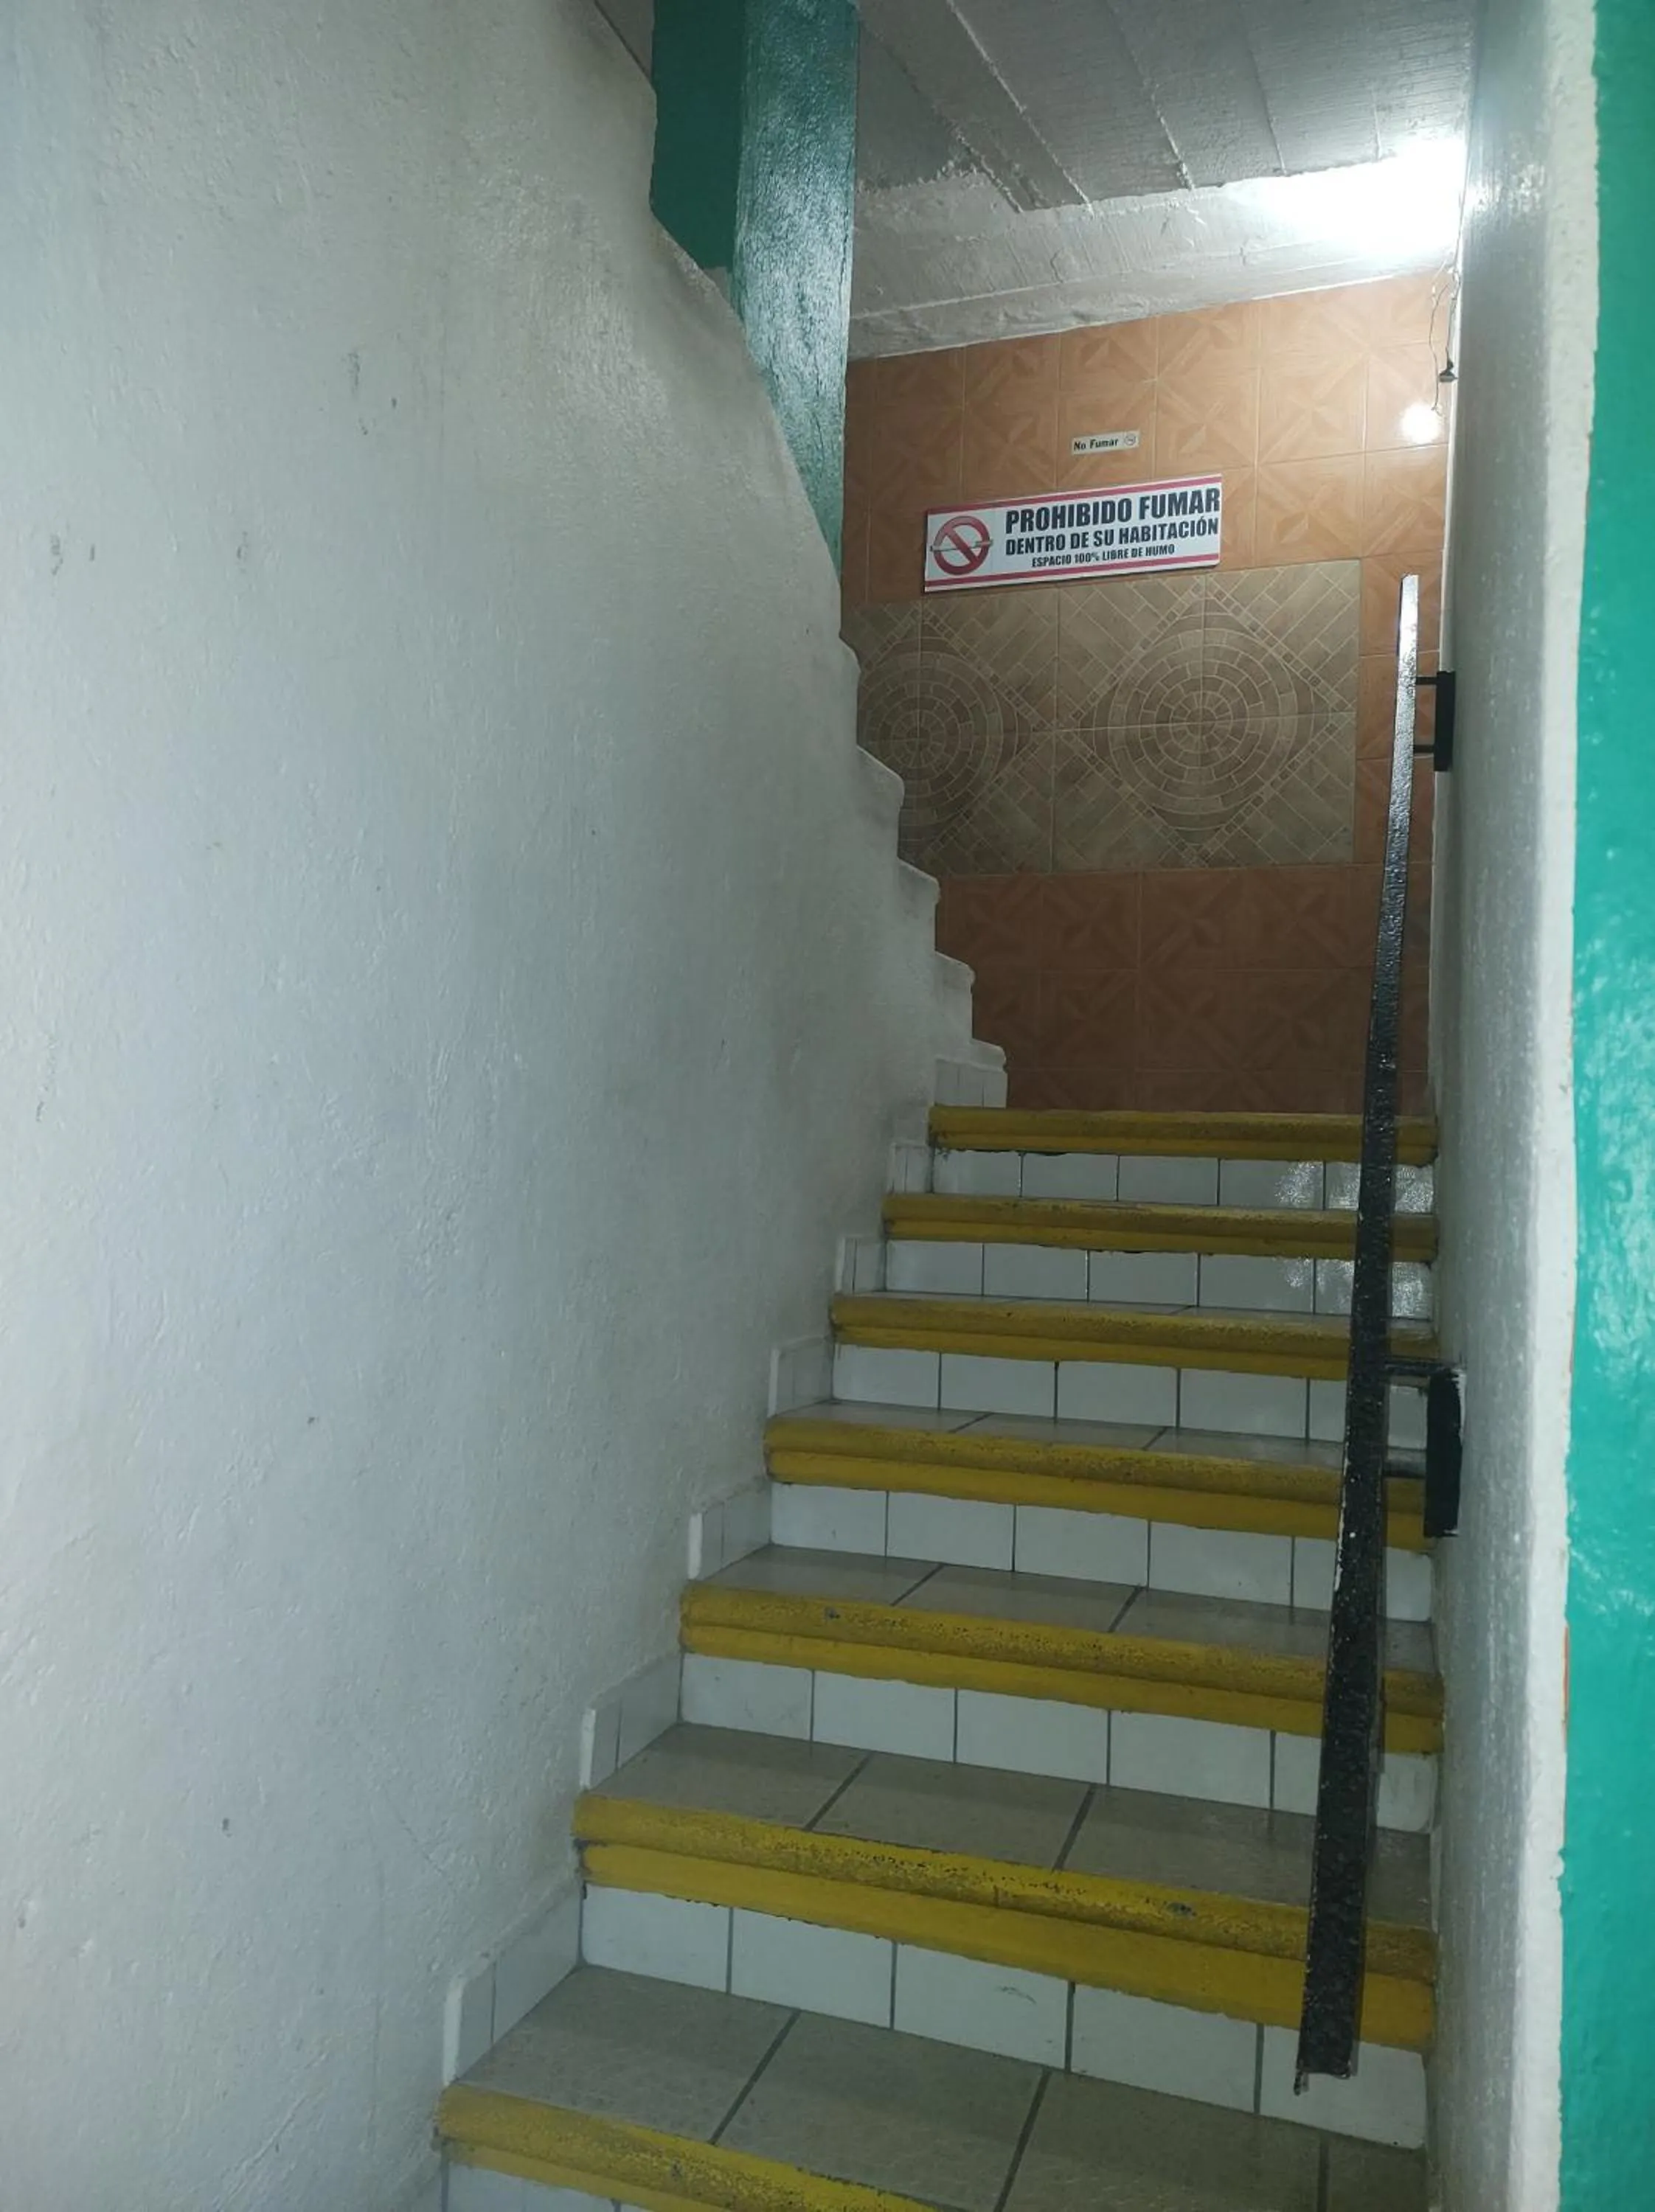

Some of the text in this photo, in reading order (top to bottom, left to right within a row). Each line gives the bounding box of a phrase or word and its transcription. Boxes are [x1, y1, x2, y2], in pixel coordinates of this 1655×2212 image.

[1073, 437, 1119, 451] No Fumar
[1005, 487, 1221, 535] PROHIBIDO FUMAR
[1005, 517, 1219, 556] DENTRO DE SU HABITACIÓN
[1032, 544, 1175, 568] ESPACIO 100% LIBRE DE HUMO
